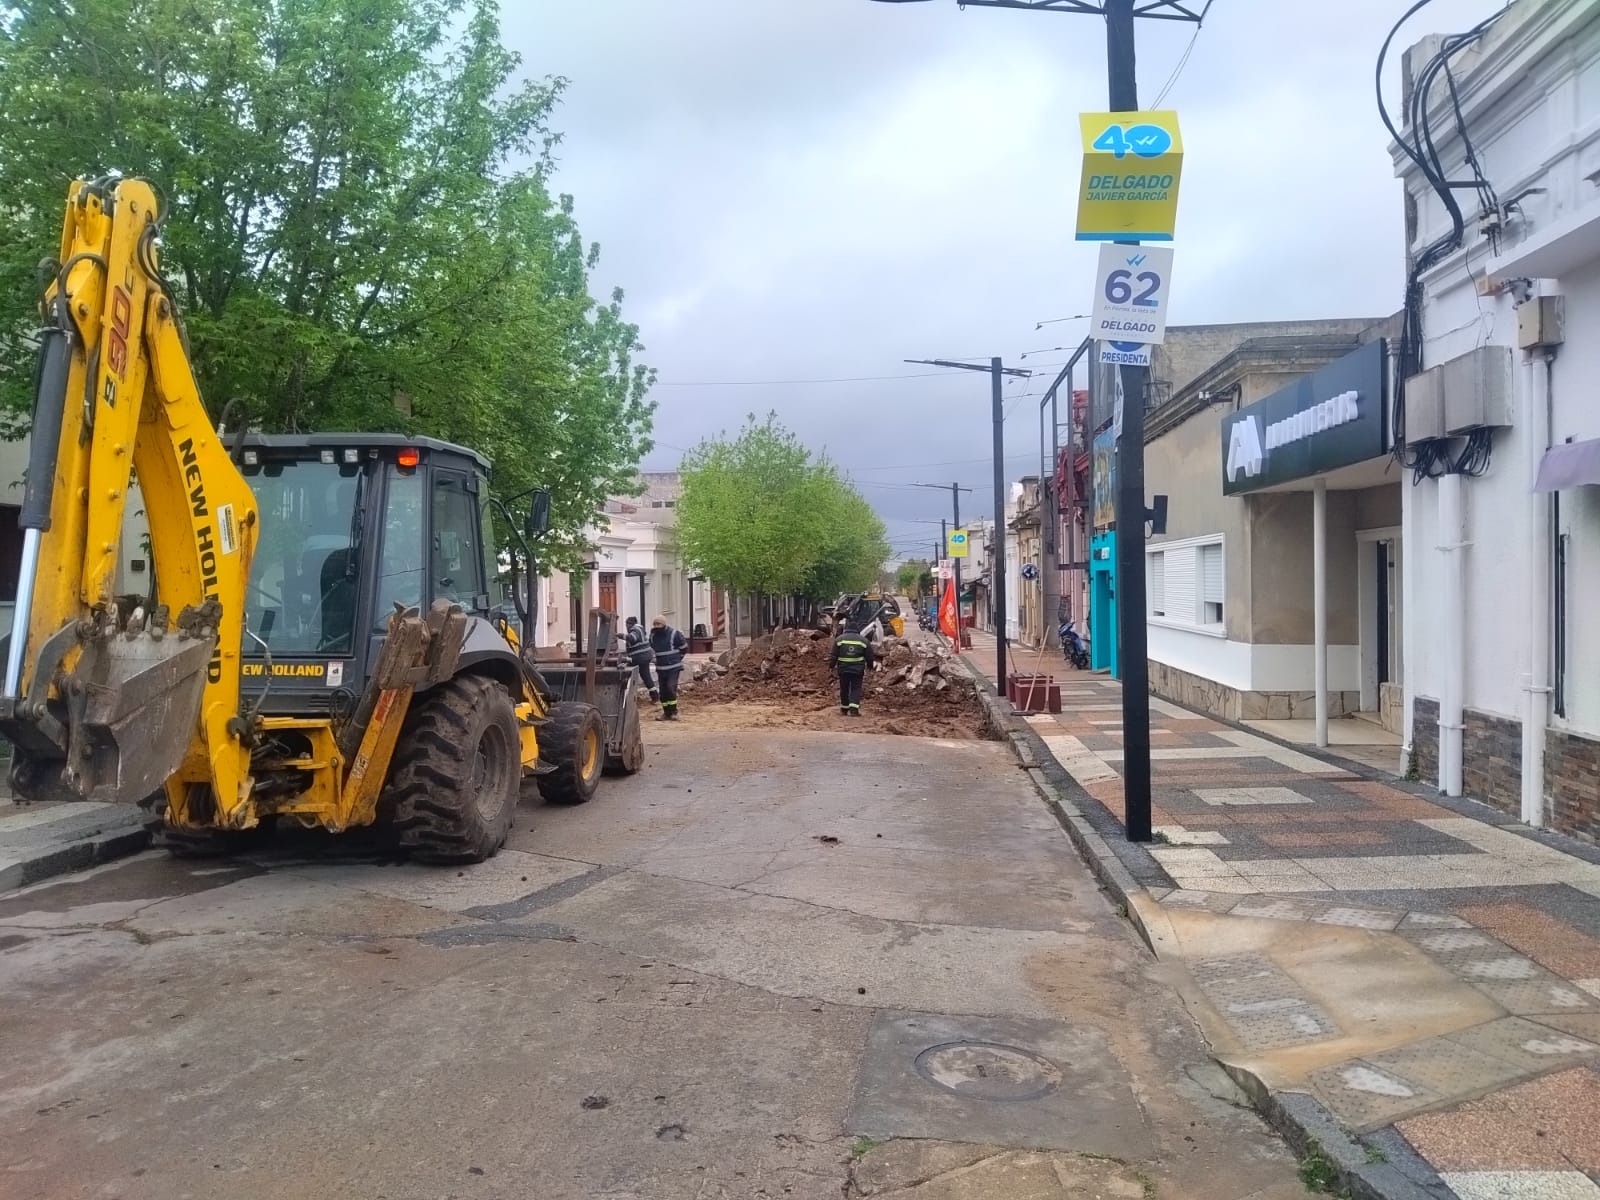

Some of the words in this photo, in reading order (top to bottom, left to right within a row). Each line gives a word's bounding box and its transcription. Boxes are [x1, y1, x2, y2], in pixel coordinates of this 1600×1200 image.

[1092, 124, 1172, 159] 40
[1088, 174, 1173, 189] DELGADO
[1086, 191, 1126, 201] JAVIER
[1127, 190, 1168, 201] GARCÍA
[1105, 269, 1160, 307] 62
[1101, 320, 1156, 332] DELGADO
[1101, 351, 1148, 364] PRESIDENTA
[179, 438, 208, 517] NEW
[242, 664, 264, 676] EW
